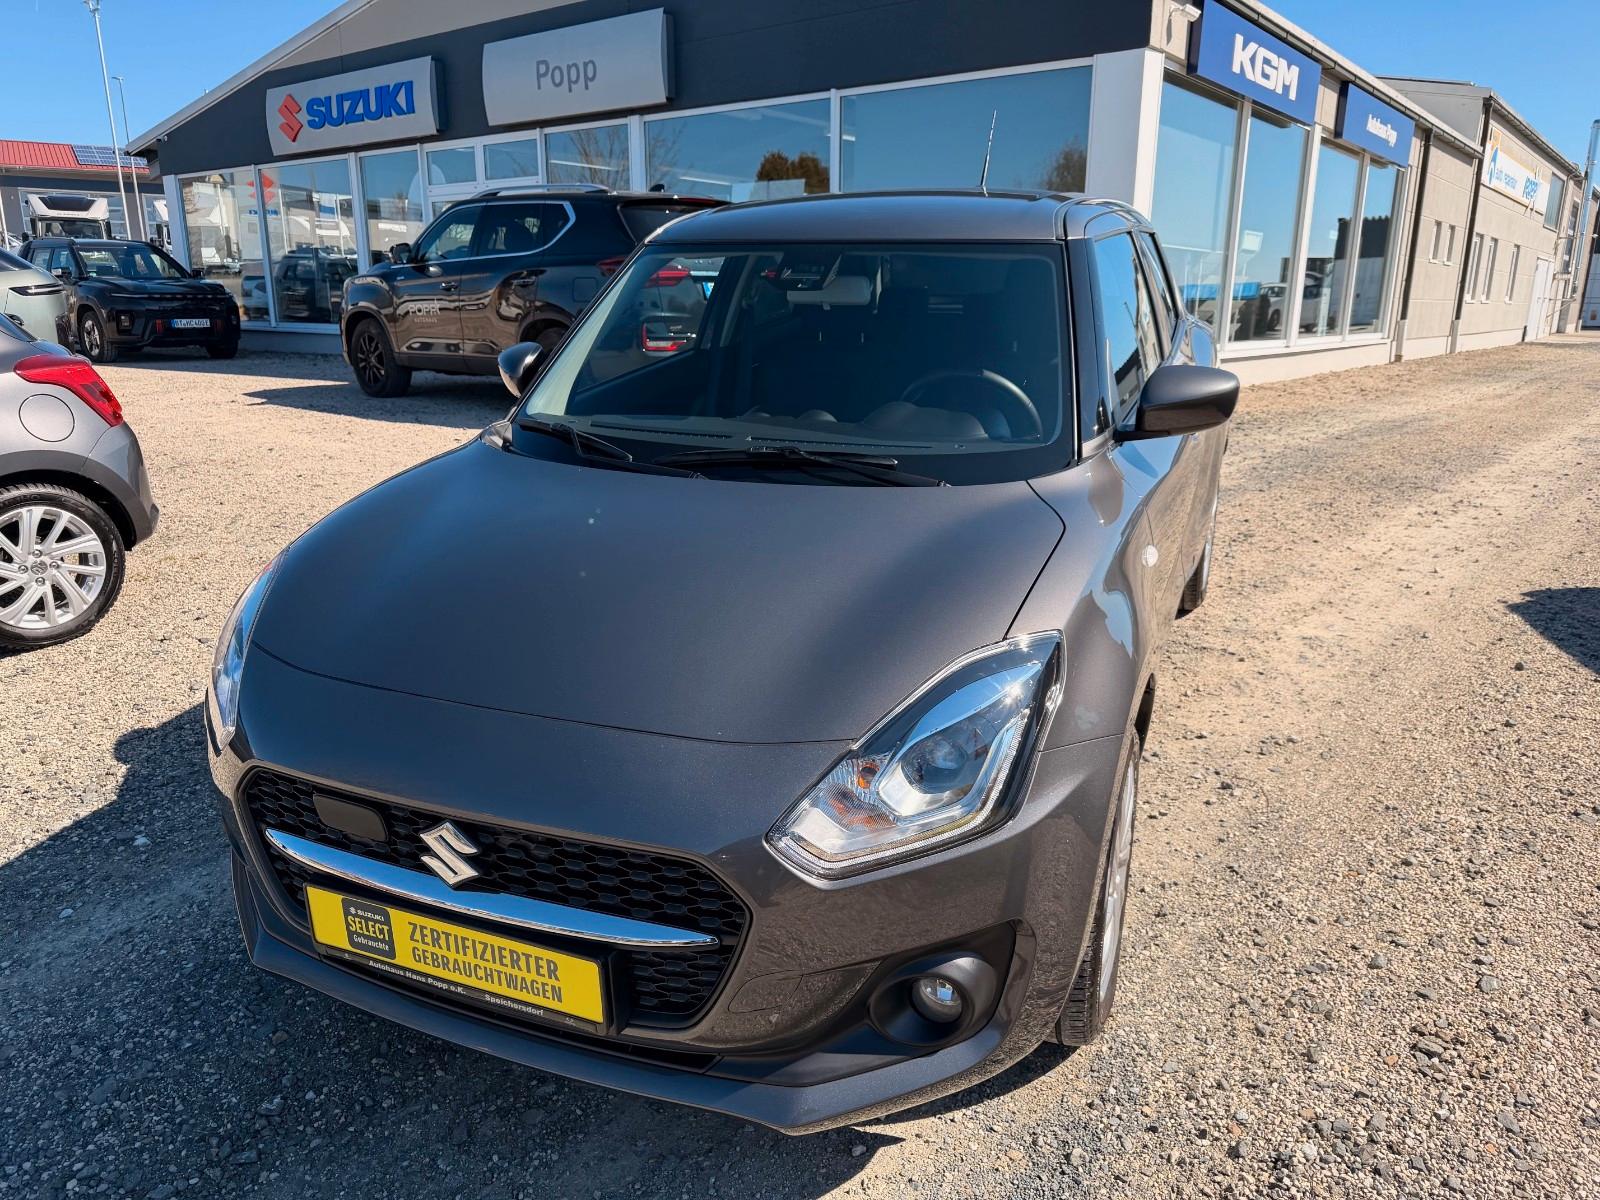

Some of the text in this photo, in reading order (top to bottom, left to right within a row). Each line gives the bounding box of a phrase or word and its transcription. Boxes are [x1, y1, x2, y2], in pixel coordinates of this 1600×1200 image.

[535, 57, 598, 94] Popp
[1232, 33, 1299, 101] KGM
[305, 80, 415, 130] SUZUKI
[347, 915, 390, 941] SELECT
[357, 909, 385, 922] SUZUKI
[353, 934, 389, 951] Gebrauchte
[407, 921, 561, 982] ZERTIFIZIERTER
[368, 959, 405, 977] Autohaus
[406, 970, 427, 983] Hans
[427, 976, 450, 990] Popp
[484, 993, 544, 1017] Speichersdorf
[412, 946, 563, 1003] GEBRAUCHTWAGEN
